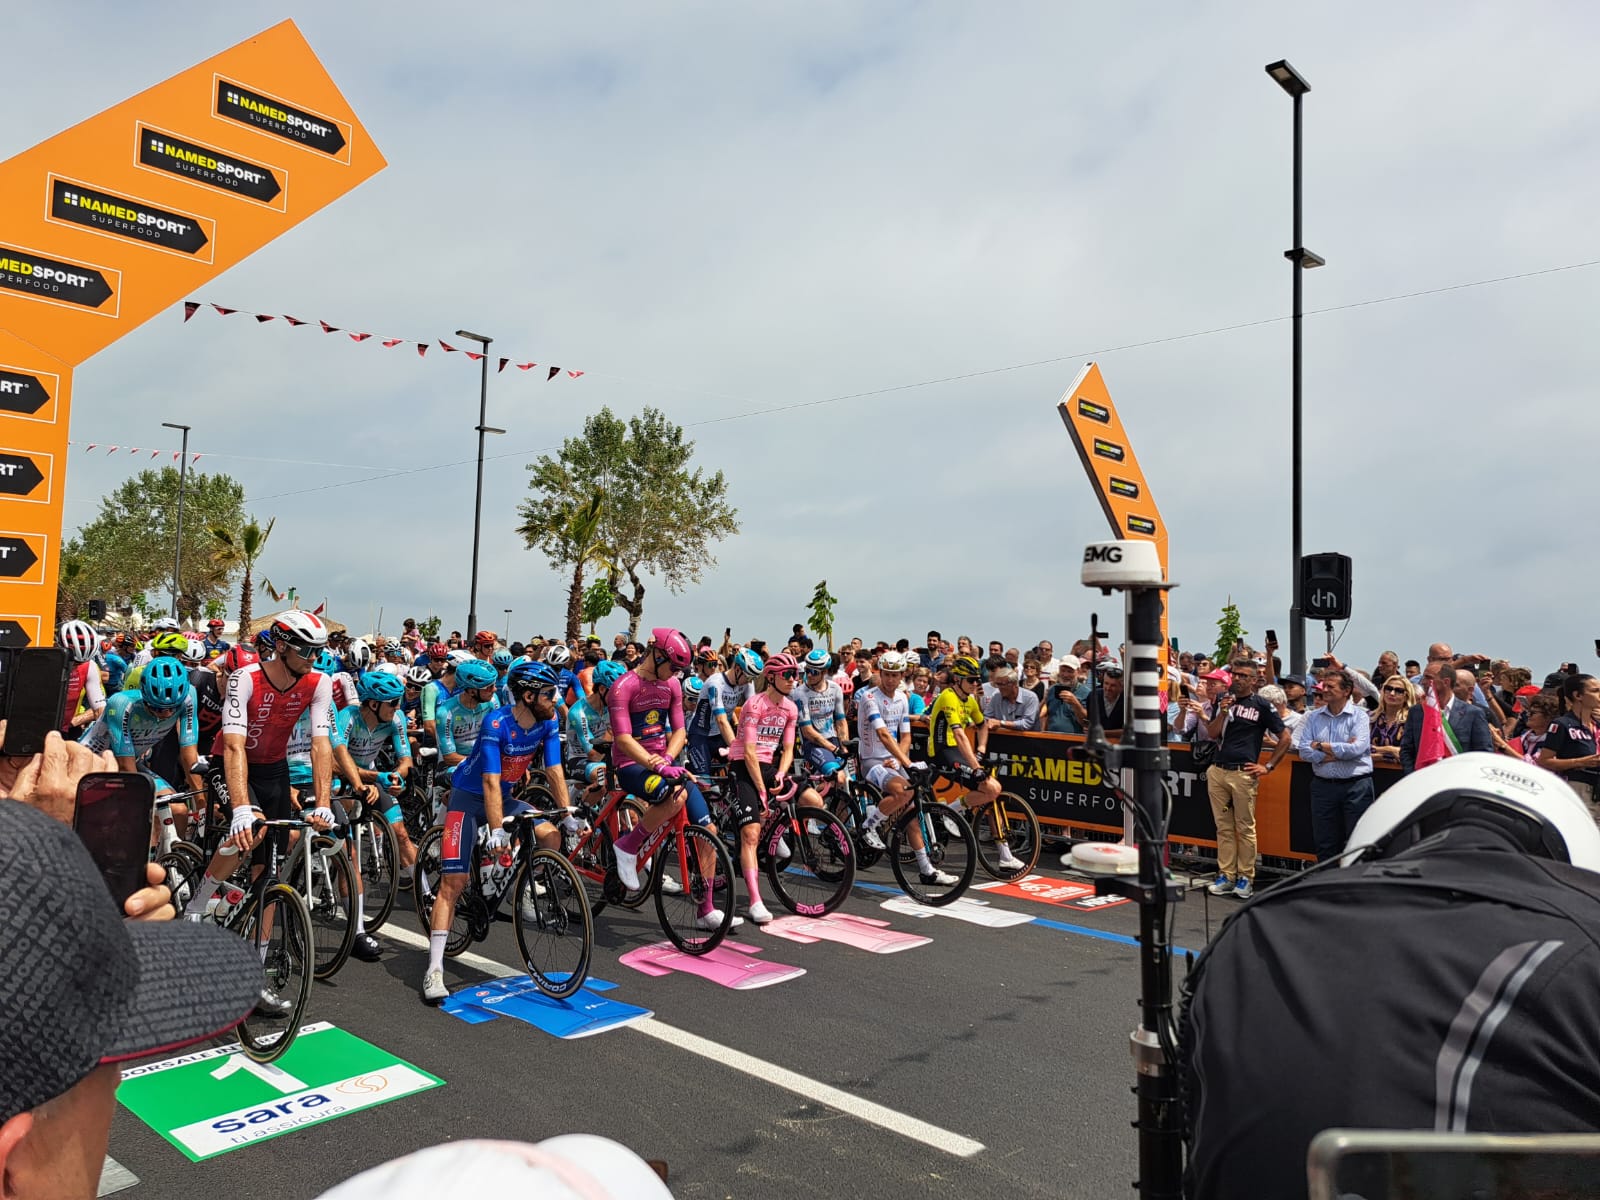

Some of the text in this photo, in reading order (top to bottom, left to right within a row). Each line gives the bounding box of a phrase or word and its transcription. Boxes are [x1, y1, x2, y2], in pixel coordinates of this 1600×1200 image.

[240, 96, 327, 137] NAMEDSPORT
[249, 113, 307, 139] SUPERFOOD
[165, 144, 261, 184] NAMEDSPORT
[175, 162, 238, 187] SUPERFOOD
[79, 196, 186, 235] NAMEDSPORT
[91, 214, 161, 239] SUPERFOOD
[1084, 546, 1123, 563] EMG
[228, 669, 244, 719] Cofidis
[245, 692, 275, 750] Cofidis
[1011, 755, 1198, 797] NAMEDSRT
[451, 821, 461, 847] Cofidis
[211, 1093, 332, 1134] sara
[230, 1104, 347, 1144] ti assicura
